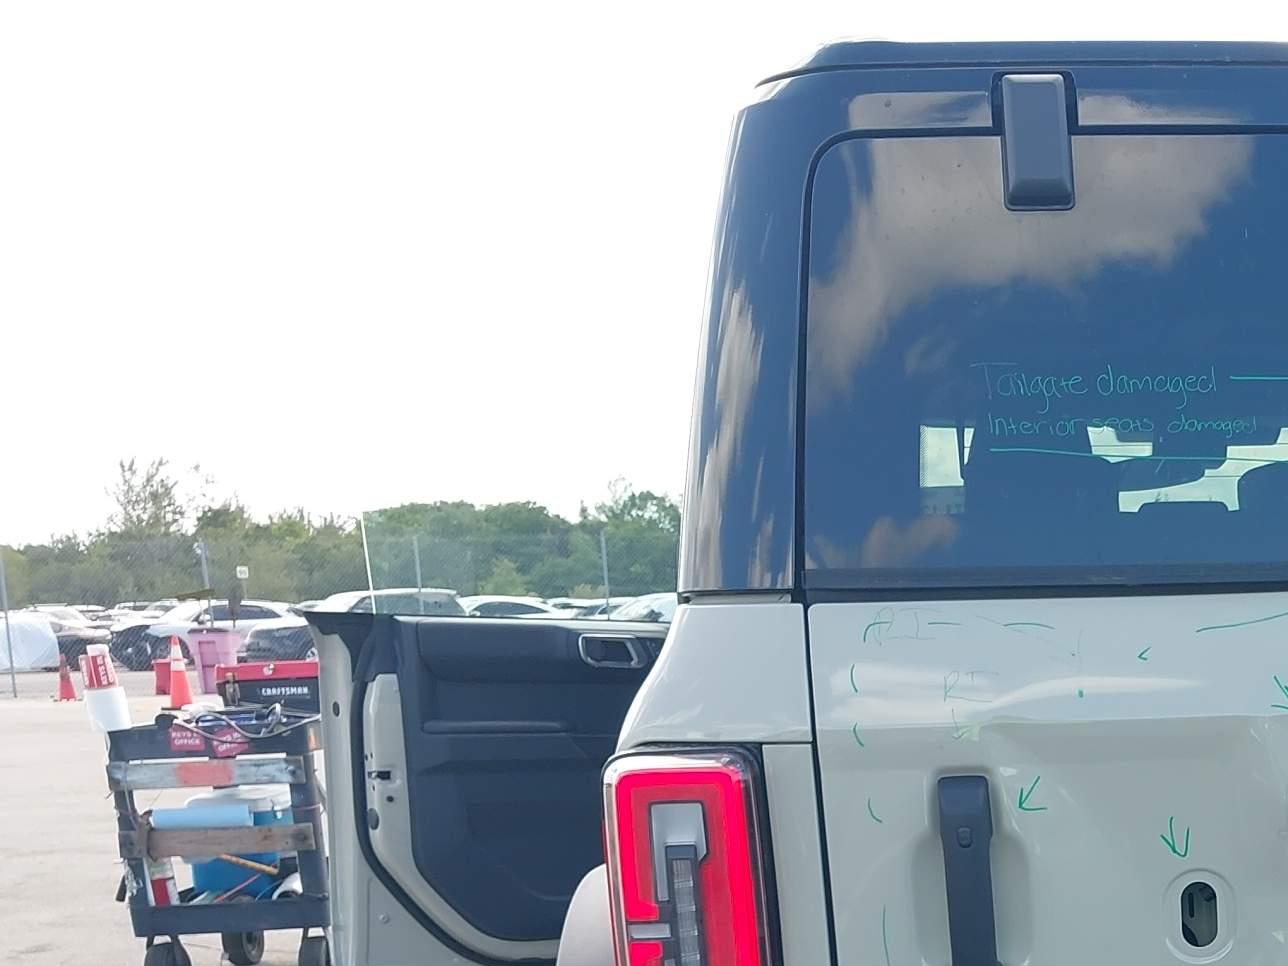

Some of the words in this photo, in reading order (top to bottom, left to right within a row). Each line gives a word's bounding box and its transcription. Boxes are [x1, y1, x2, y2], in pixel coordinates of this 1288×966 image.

[970, 362, 1088, 414] Tailgate
[1097, 365, 1217, 409] damaged
[985, 414, 1079, 437] Interior
[261, 686, 309, 696] CRAFTSMAN
